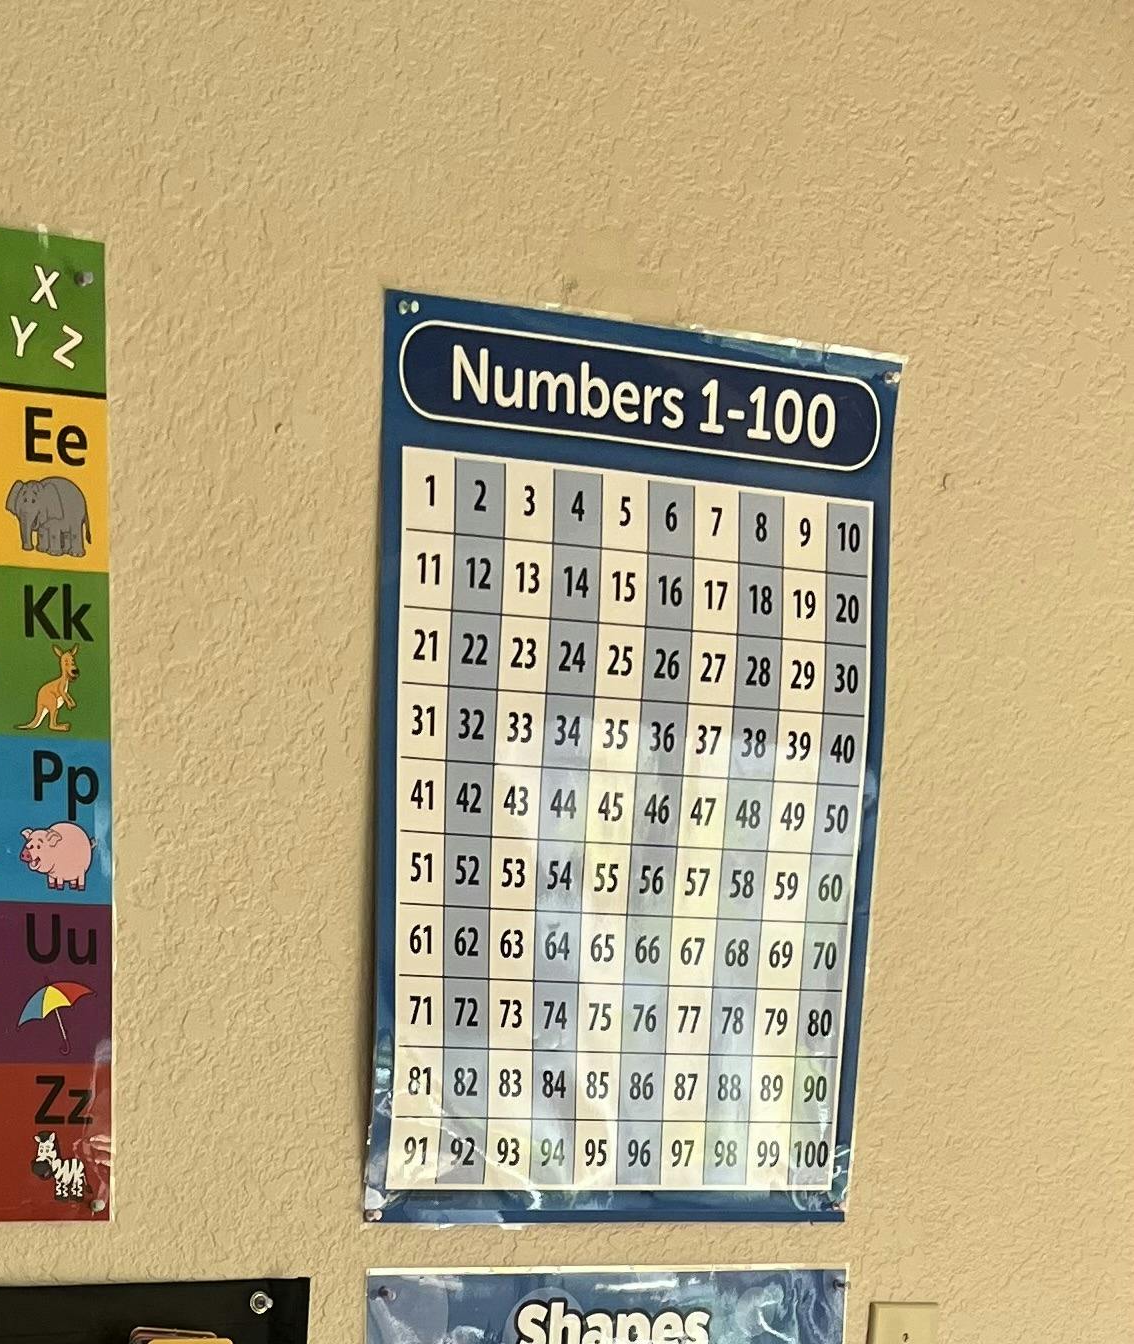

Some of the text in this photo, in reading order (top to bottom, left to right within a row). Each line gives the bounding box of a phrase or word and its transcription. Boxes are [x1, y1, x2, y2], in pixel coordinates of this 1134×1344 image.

[30, 264, 59, 309] X
[10, 316, 83, 368] Y Z
[450, 343, 838, 448] Numbers 1-100
[25, 406, 88, 466] Ee
[426, 475, 860, 552] 1 2 3 4 5 6 7 8 9 10
[23, 584, 93, 641] Kk
[418, 553, 859, 623] 11 12 13 14 15 16 17 18 19 20
[413, 629, 858, 693] 21 22 23 24 25 26 27 28 29 30
[33, 750, 99, 821] Pp
[411, 852, 842, 902] 51 52 53 54 55 56 57 58 59 60
[25, 913, 97, 965] Uu
[34, 1076, 93, 1125] Zz
[404, 1137, 828, 1167] 91 92 93 94 95 96 97 98 99 100
